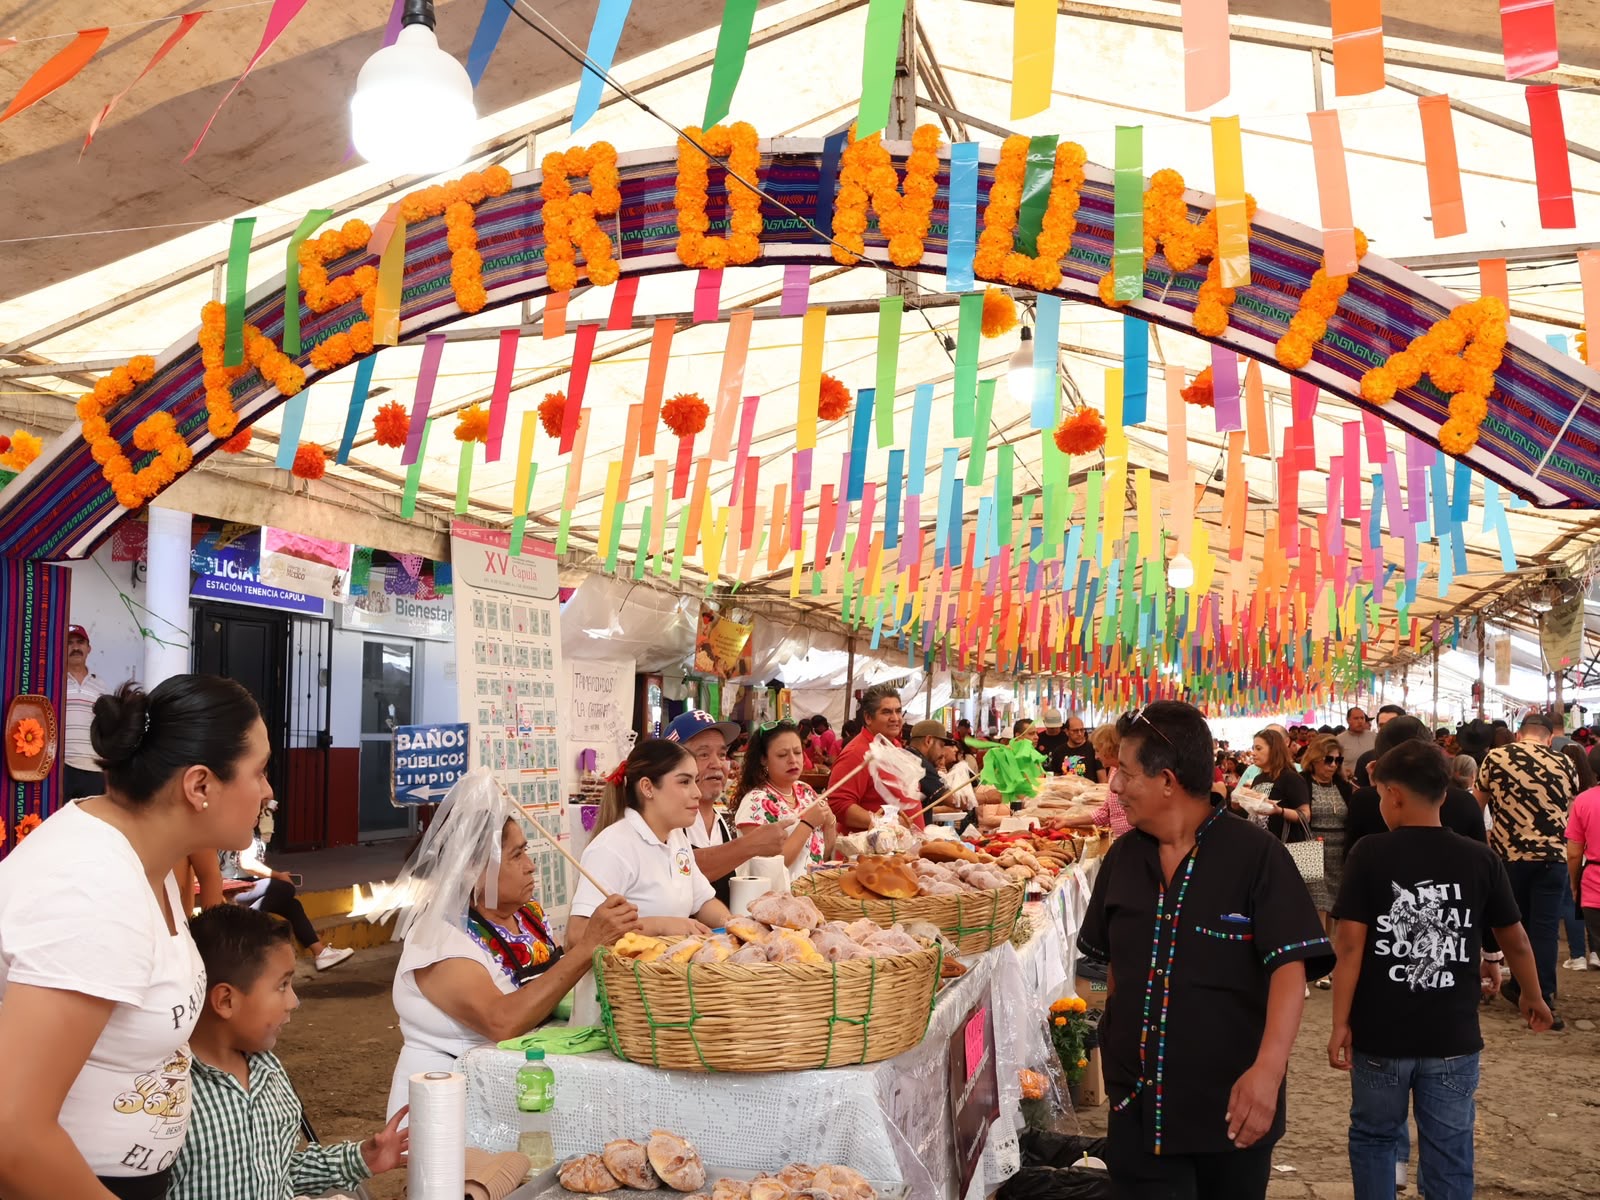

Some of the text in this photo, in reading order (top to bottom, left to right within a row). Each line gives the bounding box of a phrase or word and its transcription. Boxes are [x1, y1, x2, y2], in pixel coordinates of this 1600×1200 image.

[484, 550, 509, 575] XV
[512, 564, 537, 582] Capula
[205, 579, 306, 602] ESTACIÓN TENENCIA CAPULA
[395, 598, 453, 622] Bienestar
[396, 727, 465, 751] BAÑOS
[396, 752, 465, 769] PÚBLICOS
[396, 770, 463, 786] LIMPIOS
[1374, 936, 1470, 964] SOCIAL
[120, 1143, 154, 1171] EL
